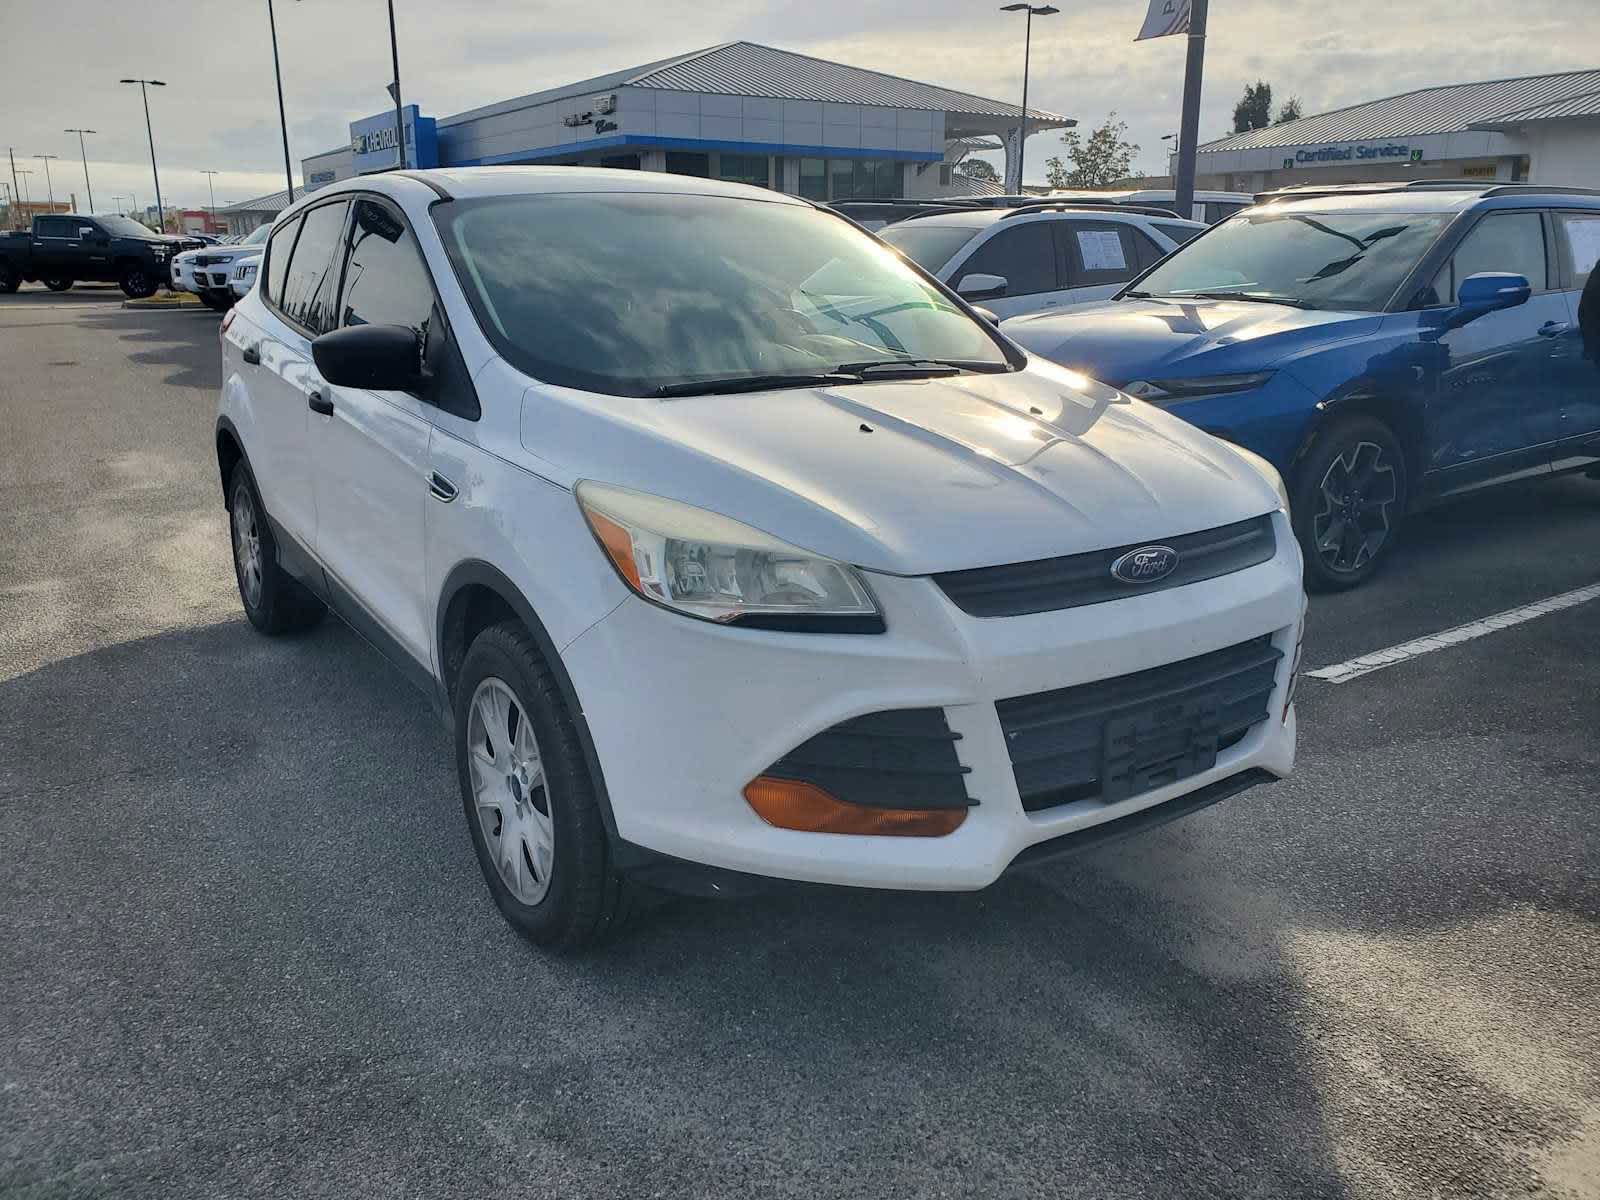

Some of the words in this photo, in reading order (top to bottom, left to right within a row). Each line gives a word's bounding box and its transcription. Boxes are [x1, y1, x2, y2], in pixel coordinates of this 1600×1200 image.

[366, 124, 411, 152] CHEVROLT
[1296, 147, 1351, 162] Certified
[1356, 143, 1409, 159] Service
